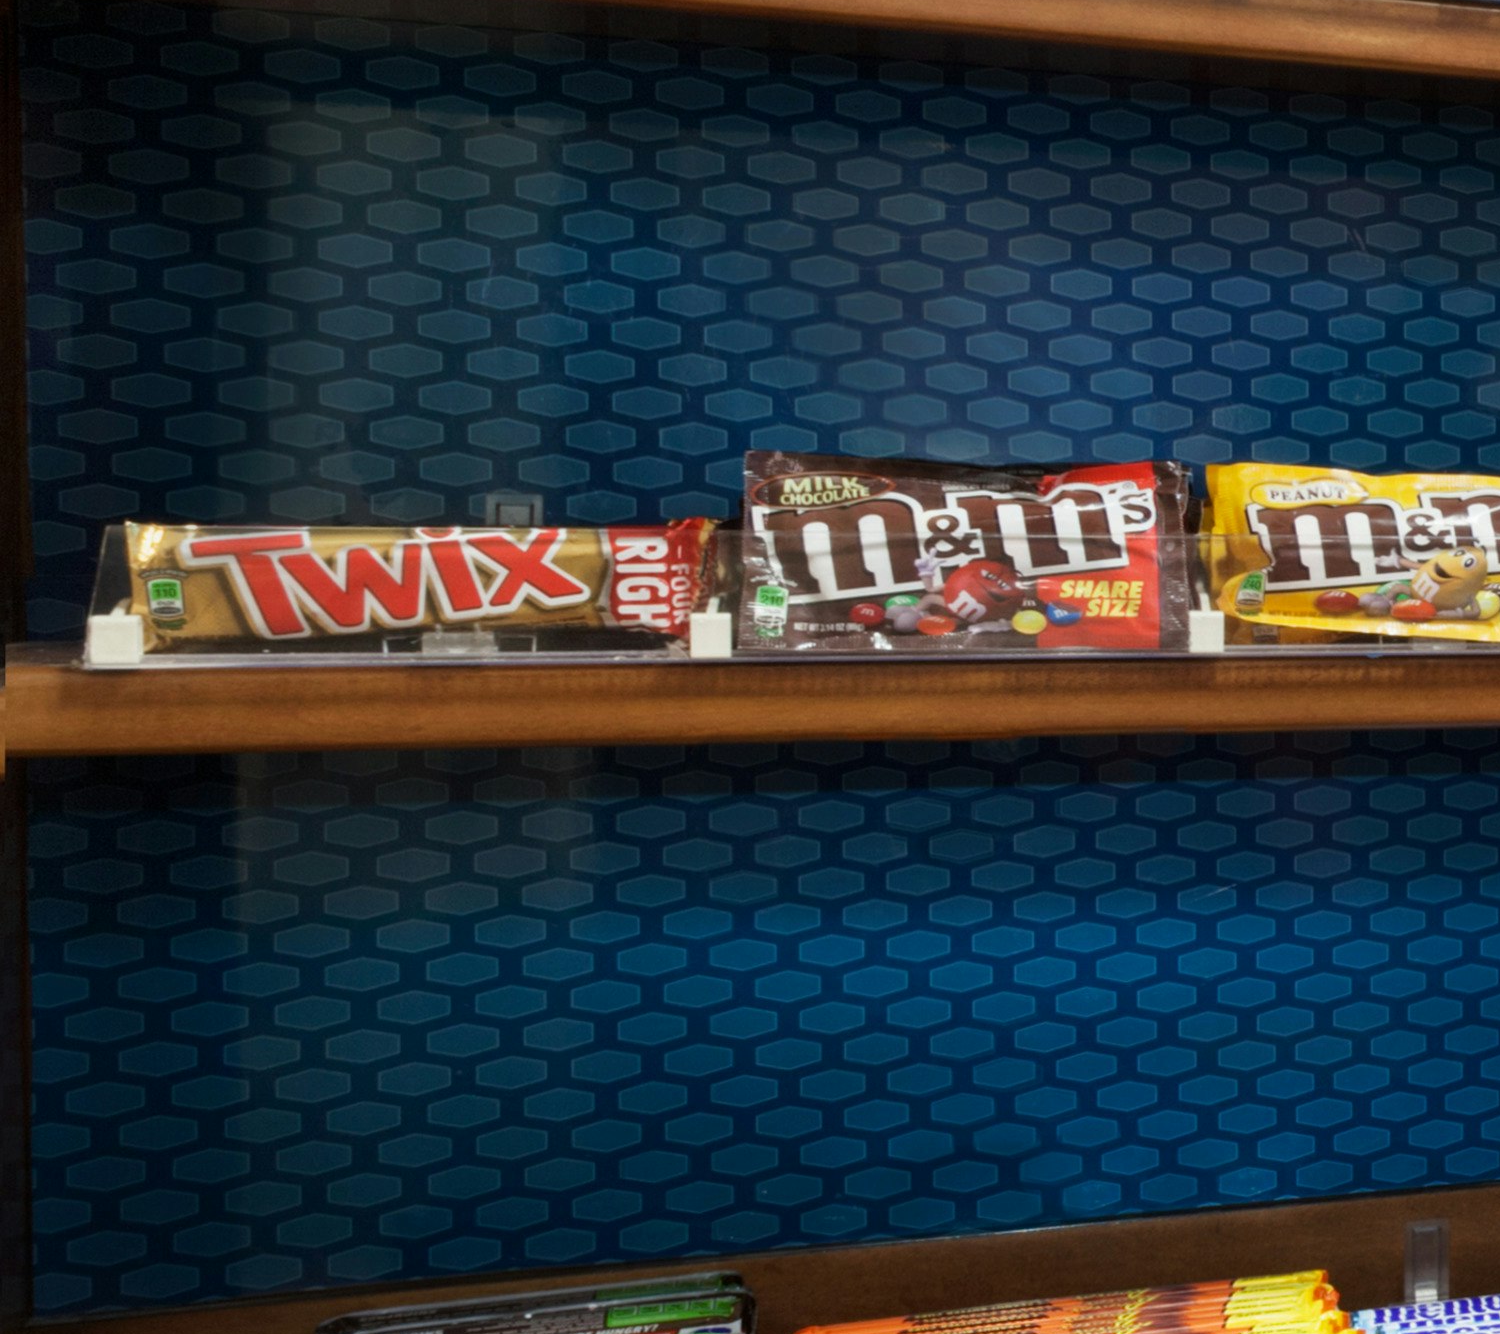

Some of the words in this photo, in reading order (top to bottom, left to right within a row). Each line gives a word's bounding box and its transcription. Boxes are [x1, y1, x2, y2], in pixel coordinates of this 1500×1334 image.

[783, 475, 859, 493] MILK
[780, 486, 871, 506] CHOCOLATE
[1269, 487, 1346, 502] PEANUT
[1060, 579, 1144, 599] SHARE
[1085, 599, 1142, 618] SIZE
